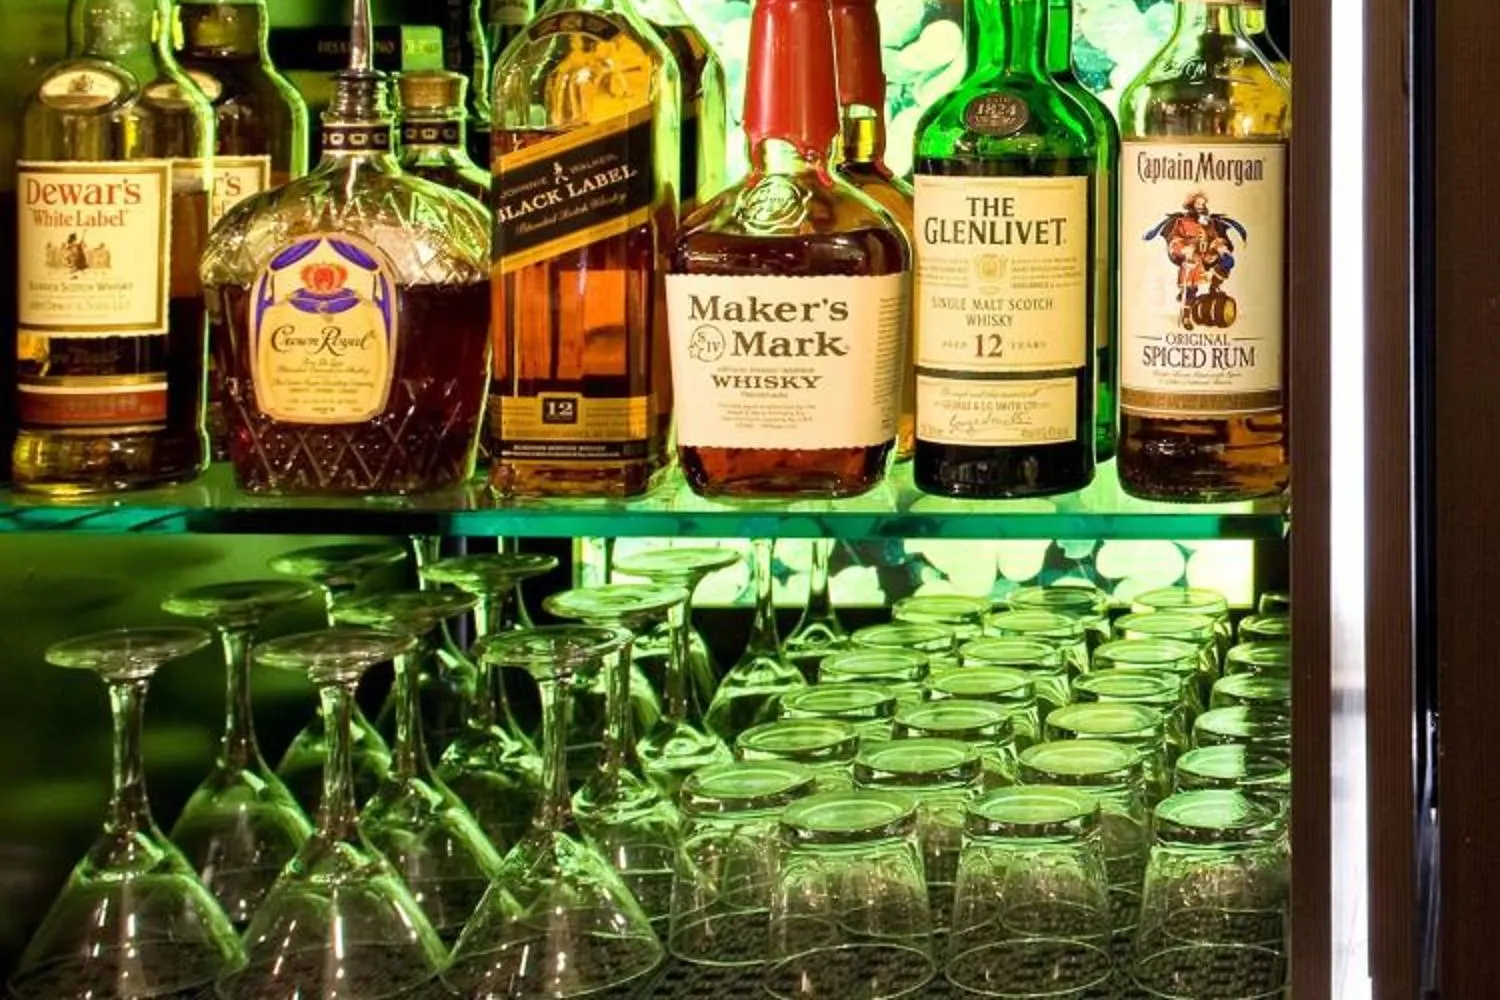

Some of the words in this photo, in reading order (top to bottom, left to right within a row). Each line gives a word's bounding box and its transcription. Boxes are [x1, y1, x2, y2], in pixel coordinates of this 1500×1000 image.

[1137, 151, 1193, 184] Captain
[1194, 151, 1264, 187] Morgan
[26, 177, 142, 206] Dewar's
[498, 188, 563, 224] BLACK
[566, 164, 639, 198] LABEL
[966, 196, 1015, 217] THE
[924, 216, 1067, 247] GLENLIVET
[687, 293, 849, 323] Maker's
[931, 296, 966, 311] SINGLE
[972, 298, 1003, 311] MALT
[1009, 297, 1053, 311] SCOTCH
[966, 313, 1014, 328] WHISKY
[271, 324, 320, 353] Crown
[313, 325, 371, 357] Royal
[730, 329, 847, 358] Mark
[974, 333, 1004, 358] 12
[1165, 332, 1230, 347] ORIGINAL
[1142, 345, 1207, 369] SPICED
[1211, 346, 1256, 372] RUM
[710, 374, 823, 390] WHISKY
[546, 401, 574, 416] 12
